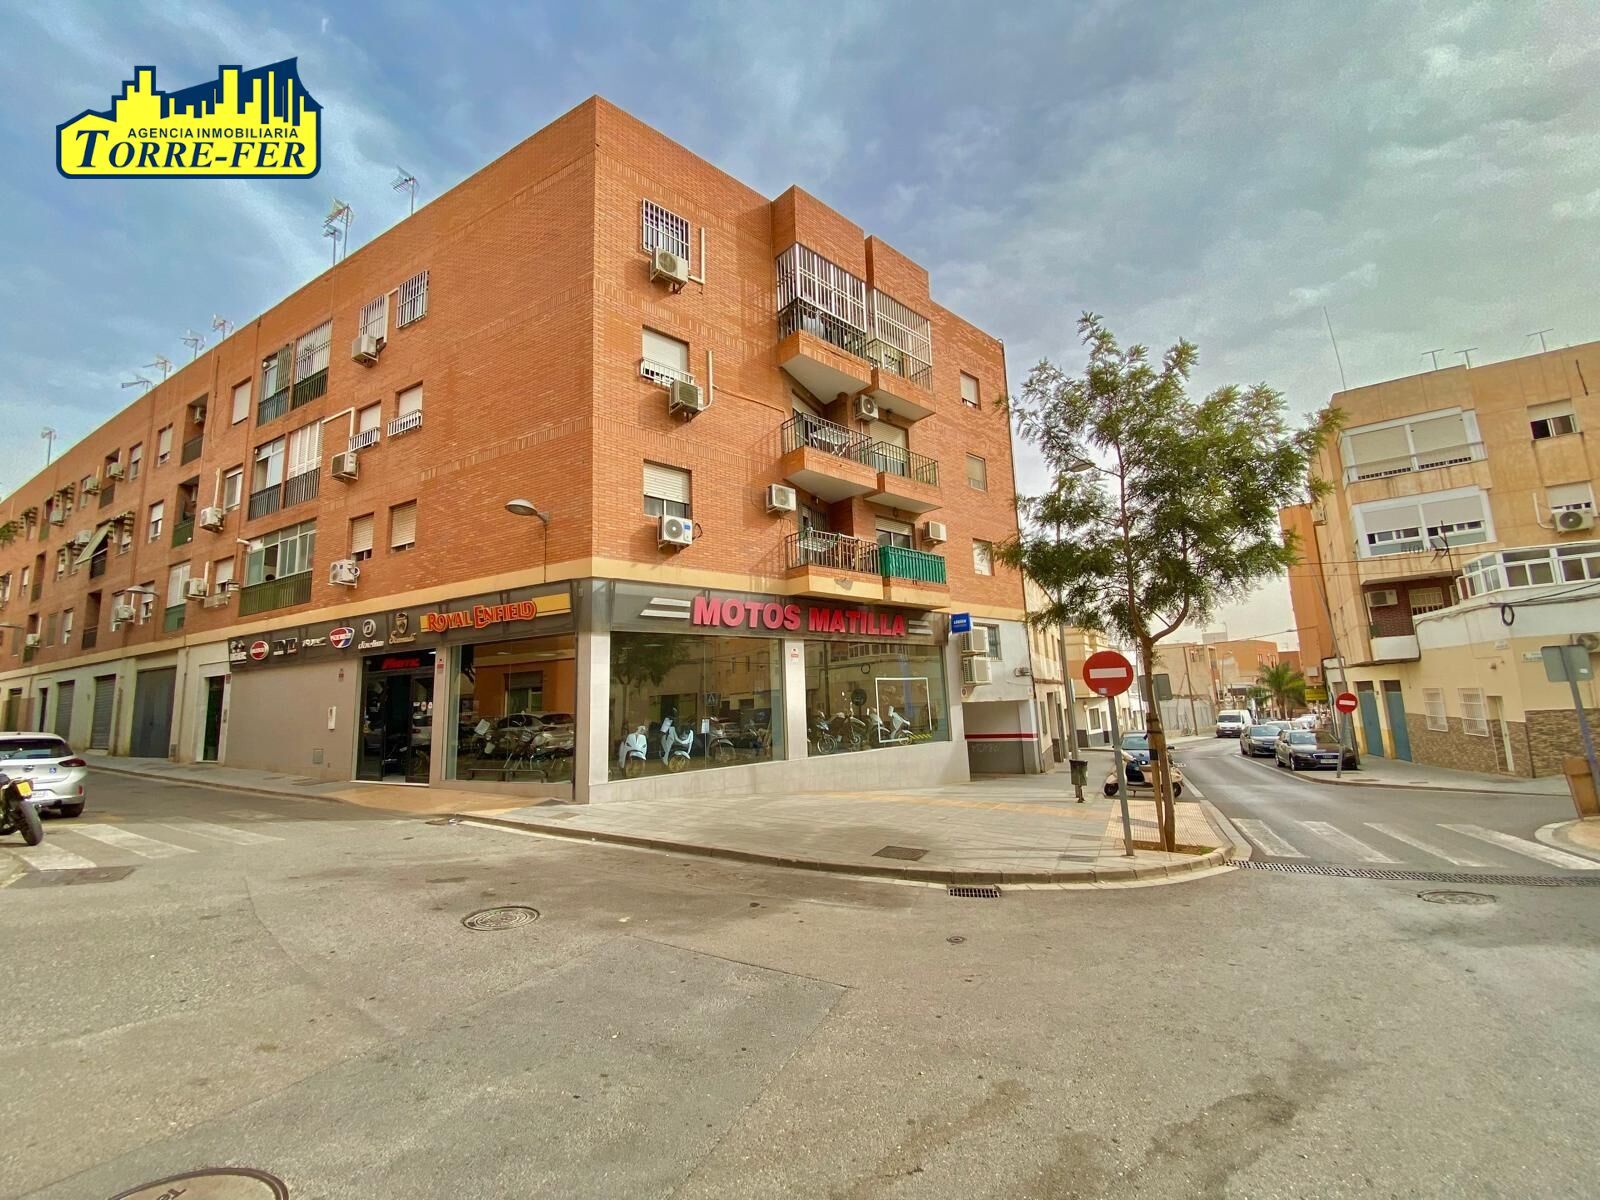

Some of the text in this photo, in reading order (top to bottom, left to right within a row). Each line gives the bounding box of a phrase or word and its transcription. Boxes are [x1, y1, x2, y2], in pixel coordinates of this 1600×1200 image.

[426, 601, 537, 633] ROYAL ENFIELD
[692, 596, 906, 636] MOTOS MATILLA
